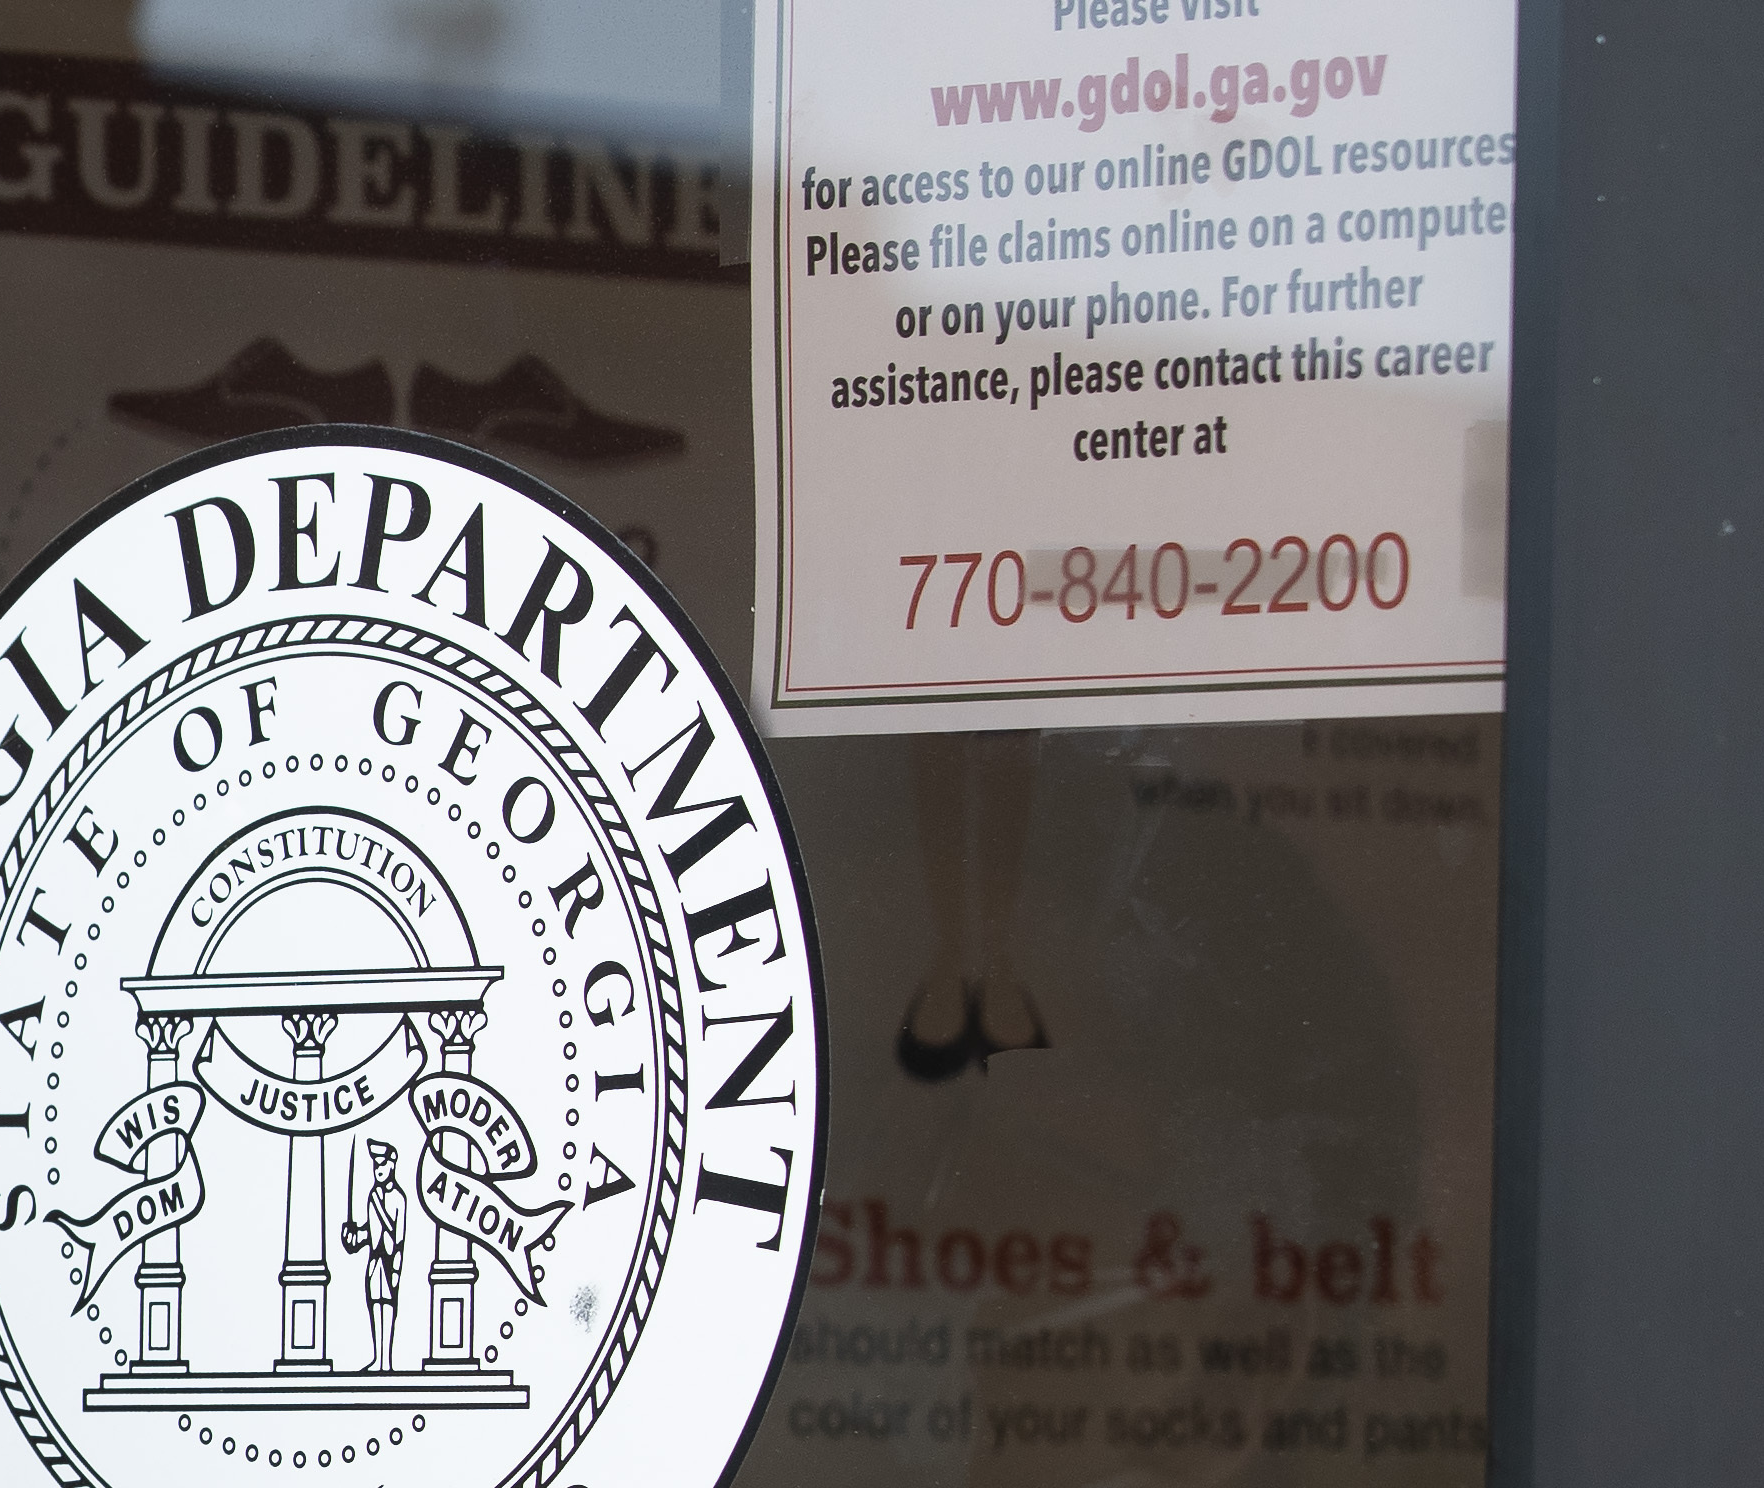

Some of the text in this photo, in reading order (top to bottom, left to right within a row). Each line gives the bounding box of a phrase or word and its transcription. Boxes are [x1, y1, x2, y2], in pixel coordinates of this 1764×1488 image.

[1054, 0, 1169, 31] Please
[930, 53, 1388, 133] www.gdol.ga.gov
[802, 166, 852, 210] for
[861, 169, 969, 206] access
[980, 161, 1013, 198] to
[1025, 160, 1085, 195] our
[1095, 143, 1210, 190] online
[1223, 135, 1322, 181] GDOL
[807, 197, 1507, 276] Please file claims online on a compute
[896, 266, 1424, 345] or on your phone. For further
[831, 336, 1495, 410] assistance, please contact this career
[1073, 416, 1227, 461] center at
[899, 533, 1411, 631] 770-840-2200
[165, 471, 798, 1253] DEPARTMENT
[188, 824, 441, 929] CONSTITUTION
[172, 675, 283, 773] OF
[371, 679, 647, 1213] GEORGIA
[115, 1094, 181, 1150] WIS
[240, 1075, 375, 1122] JUSTICE
[422, 1088, 522, 1171] MODER
[112, 1181, 185, 1242] DOM
[426, 1171, 524, 1252] ATION
[810, 1202, 1448, 1306] Shoes & belt
[787, 1391, 914, 1441] color
[987, 1407, 1087, 1453] your
[1262, 1405, 1349, 1453] and
